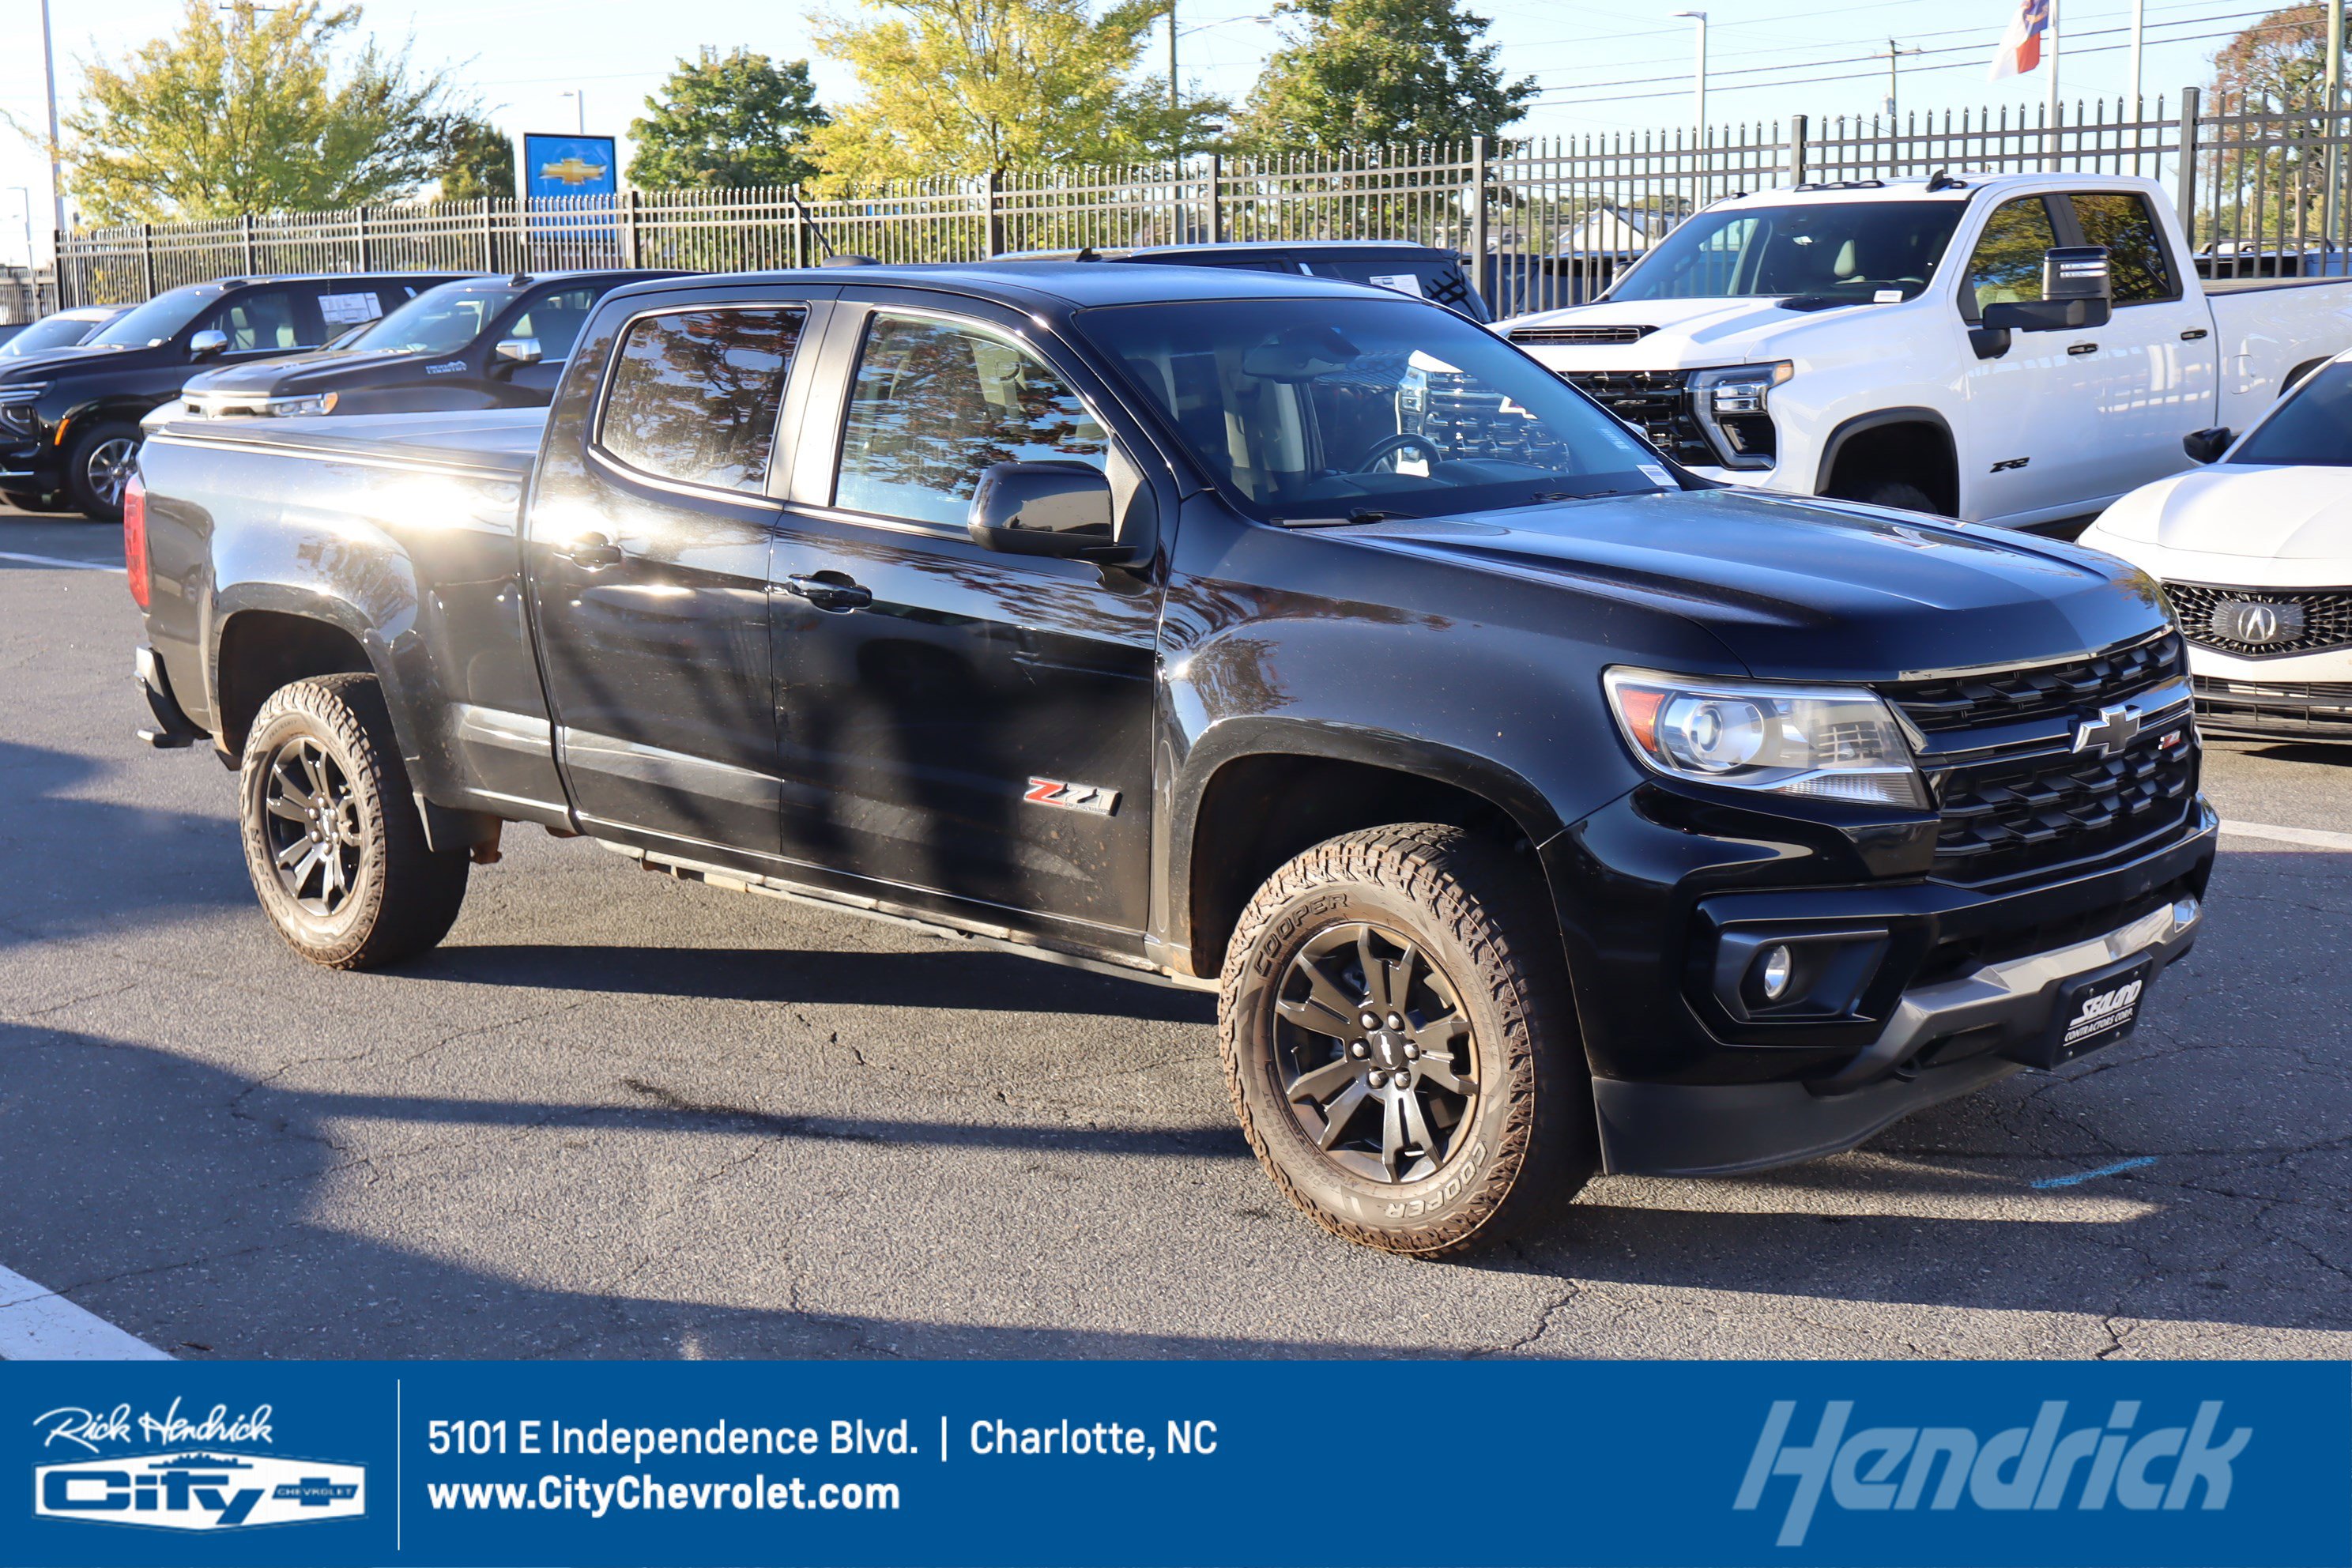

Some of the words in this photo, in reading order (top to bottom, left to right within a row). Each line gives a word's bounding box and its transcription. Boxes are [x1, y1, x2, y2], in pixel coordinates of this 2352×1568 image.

[1023, 776, 1123, 817] Z71
[1253, 892, 1348, 977] COOPER
[2064, 1015, 2116, 1042] CONTRACTORS
[1385, 1140, 1488, 1219] COOPER
